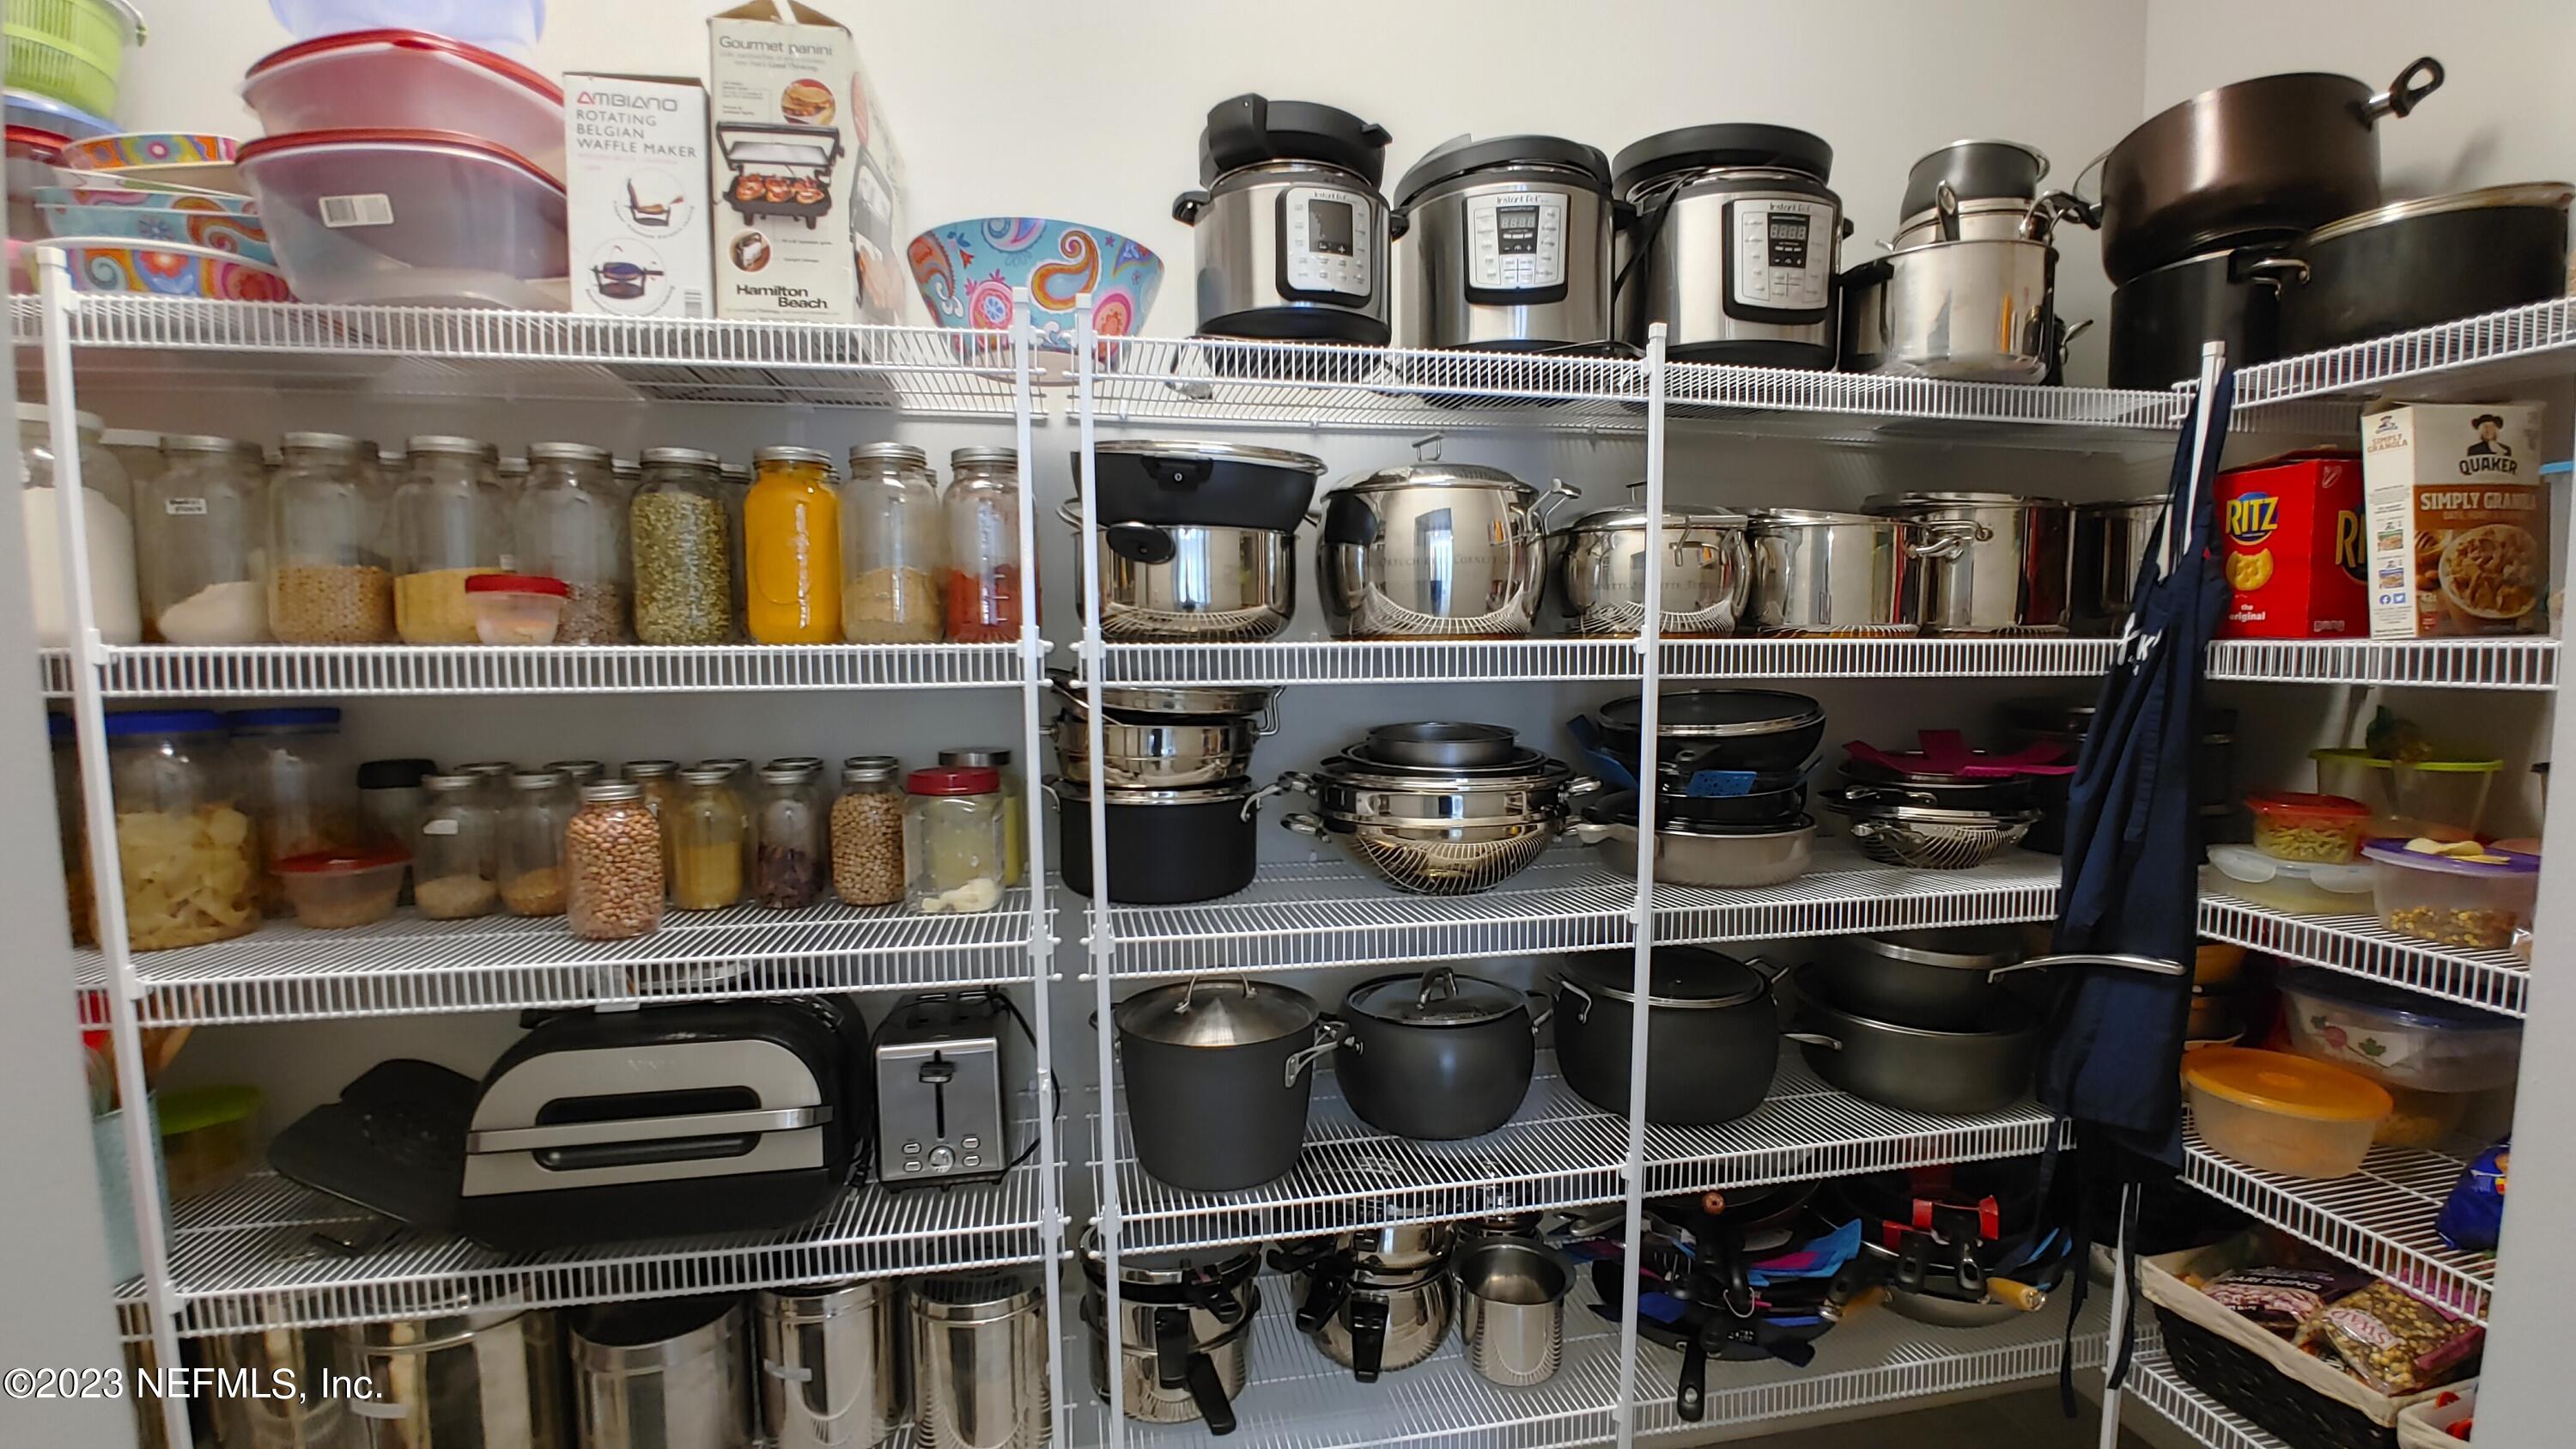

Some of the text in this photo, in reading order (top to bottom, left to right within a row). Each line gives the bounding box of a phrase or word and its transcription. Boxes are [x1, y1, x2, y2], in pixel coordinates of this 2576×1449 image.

[719, 35, 833, 56] Gourmet panini
[576, 90, 678, 113] AMBIANO
[576, 109, 657, 126] ROTATING
[576, 124, 645, 139] BELGIAN
[576, 137, 697, 158] WAFFLE MAKER
[736, 284, 809, 297] Hamilton
[778, 297, 828, 309] Beach
[2458, 457, 2518, 476] QUAKER
[2420, 492, 2481, 510] SIMPLY
[2226, 496, 2279, 536] RITZ
[2228, 611, 2266, 623] original
